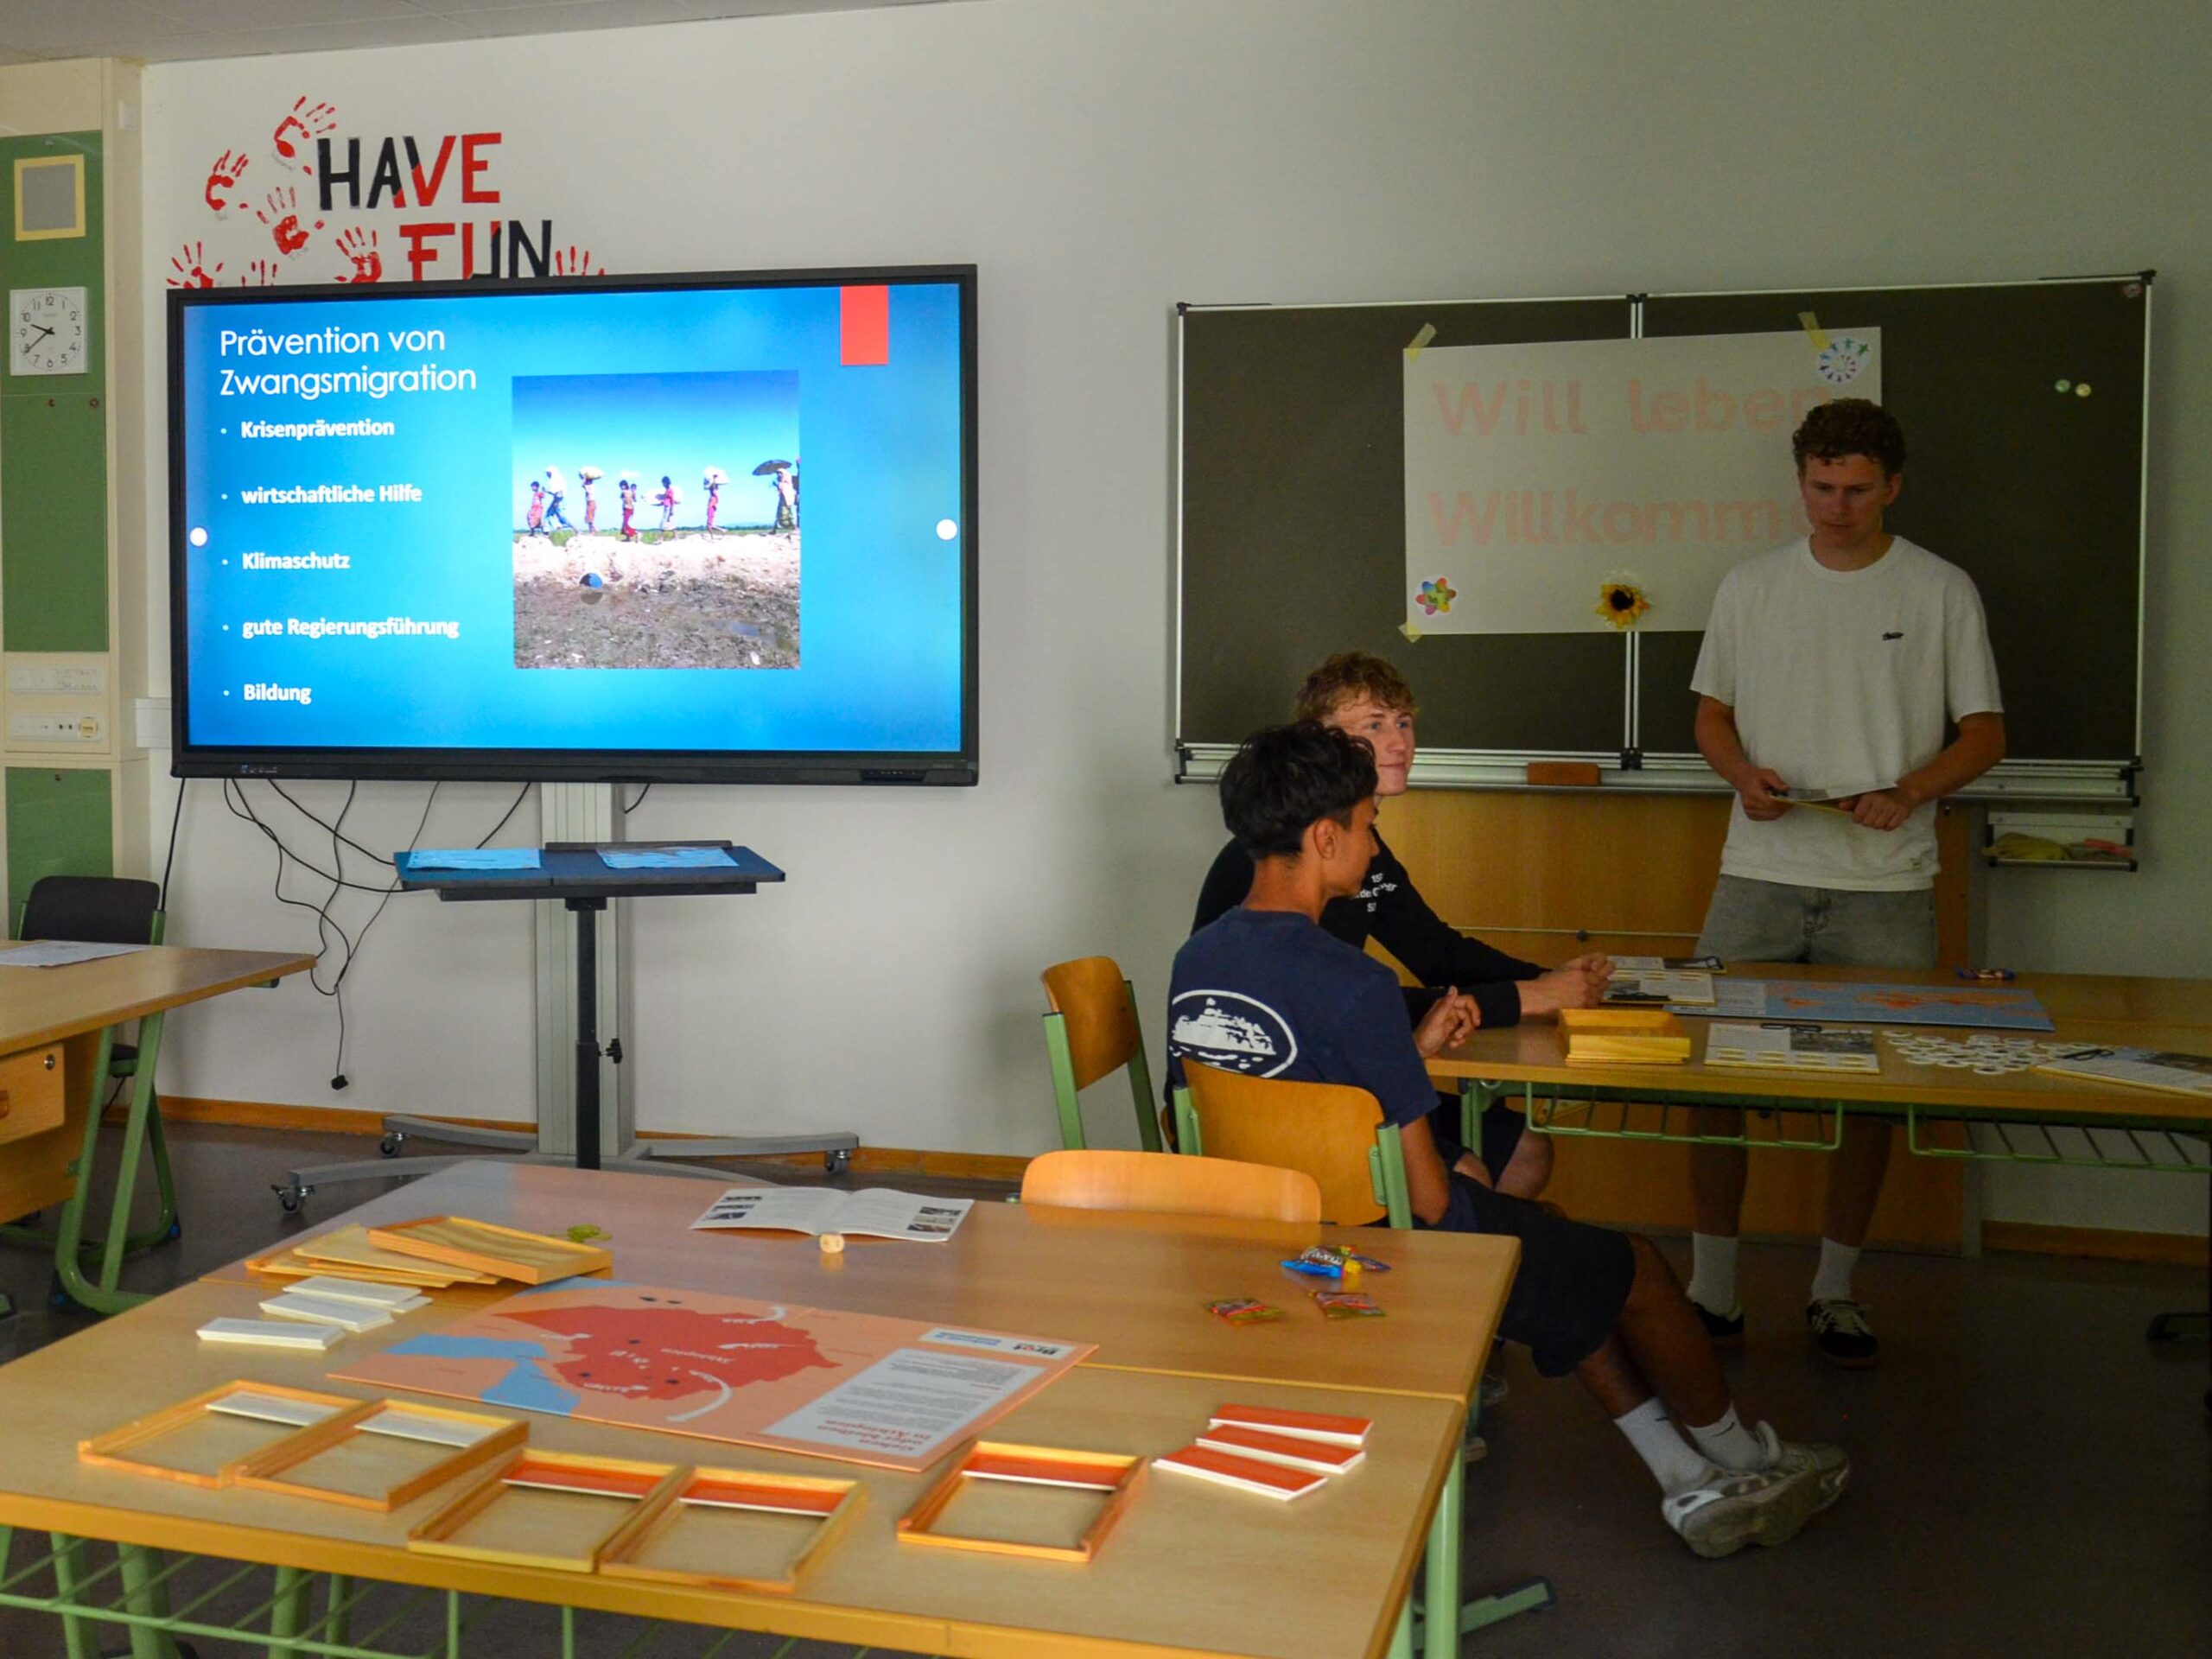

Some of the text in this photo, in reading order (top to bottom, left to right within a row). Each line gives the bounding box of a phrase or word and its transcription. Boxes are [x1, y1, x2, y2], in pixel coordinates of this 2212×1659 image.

[316, 132, 502, 211] HAVE
[398, 219, 553, 283] FUN
[220, 327, 446, 356] Prävention von
[220, 363, 477, 400] Zwangsmigration
[1432, 378, 1589, 437] Will
[240, 419, 395, 441] Krisenprävention
[241, 484, 423, 505] wirtschaftliche Hilfe
[242, 551, 351, 570] Klimaschutz
[242, 617, 460, 639] gute Regierungsführung
[243, 683, 312, 705] Bildung
